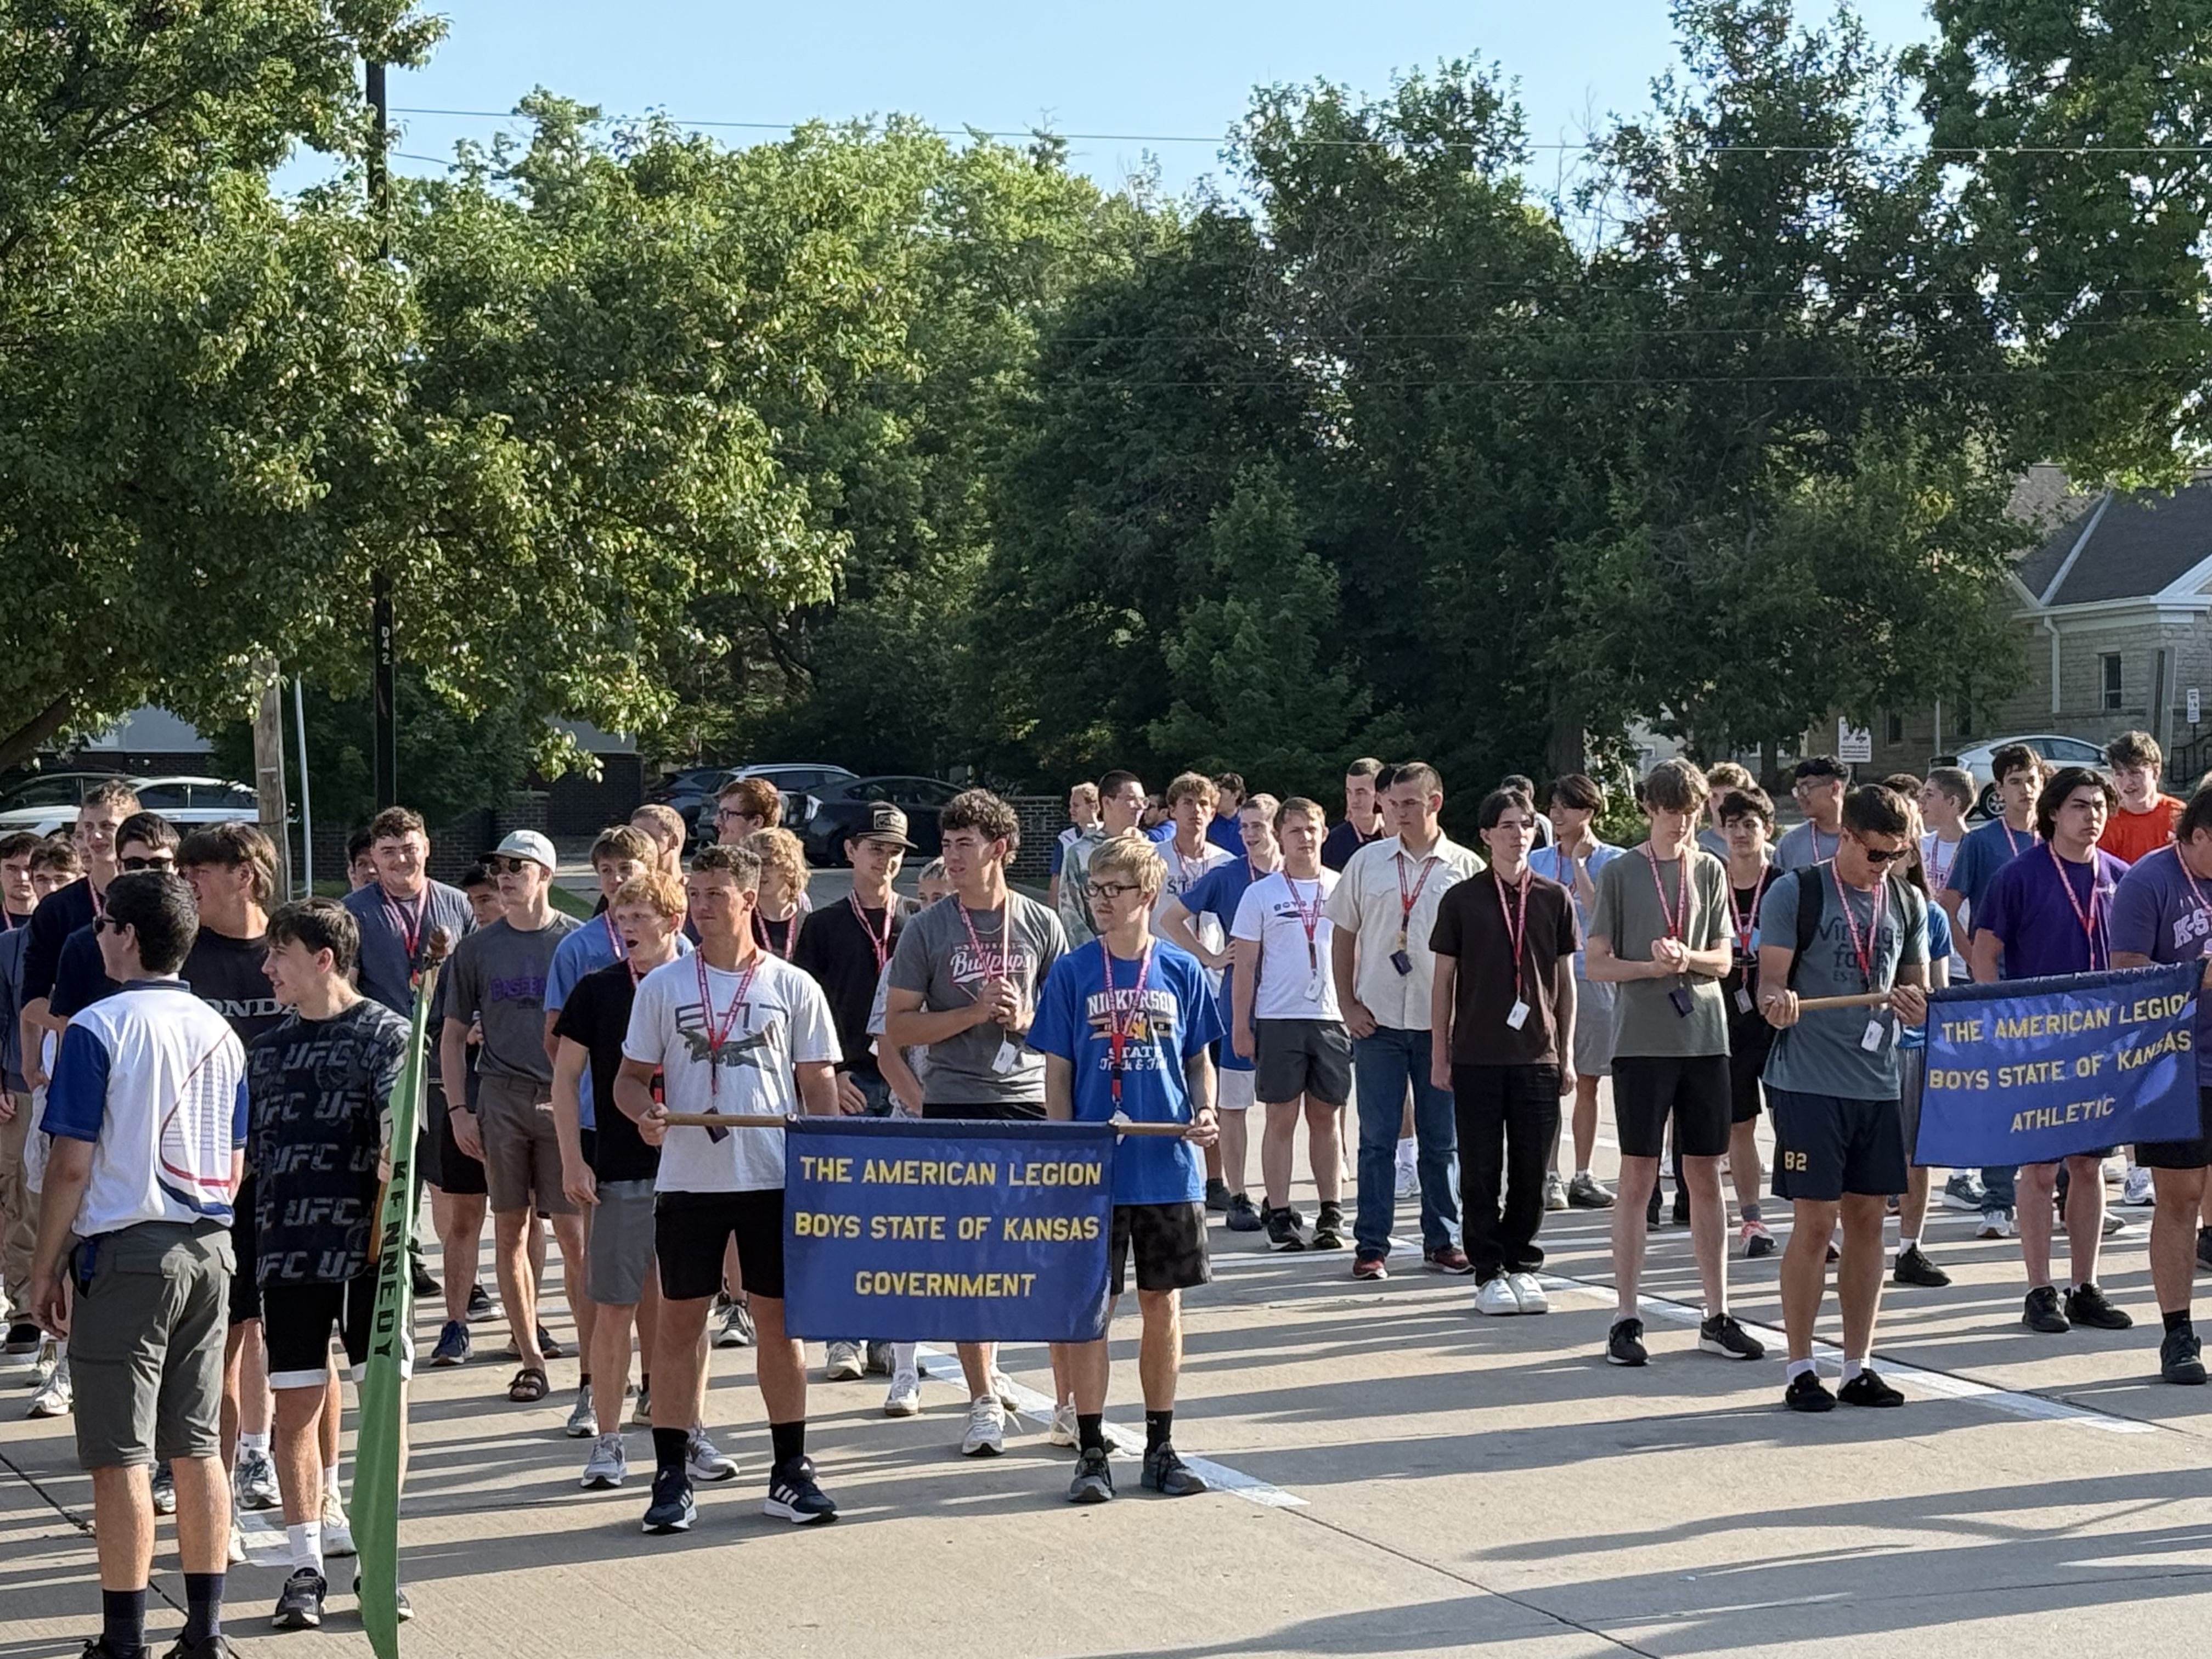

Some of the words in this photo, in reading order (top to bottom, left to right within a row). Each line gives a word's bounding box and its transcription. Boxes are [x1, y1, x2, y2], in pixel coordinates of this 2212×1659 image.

[204, 998, 300, 1017] ONDA
[1942, 1020, 1984, 1043] THE
[1994, 1007, 2111, 1039] AMERICAN
[1929, 1069, 1990, 1090] BOYS
[1997, 1060, 2066, 1088] STATE
[2075, 1053, 2104, 1078] OF
[2117, 1029, 2192, 1072] KANSAS
[313, 1091, 368, 1119] UF
[2010, 1097, 2116, 1134] ATHLETIC
[799, 1155, 854, 1183] THE
[861, 1158, 996, 1186] AMERICAN
[1008, 1161, 1102, 1186] LEGION
[282, 1198, 362, 1227] UFC
[794, 1211, 861, 1238] BOYS
[870, 1215, 946, 1240] STATE
[958, 1216, 992, 1240] OF
[1003, 1216, 1100, 1242] KANSAS
[317, 1251, 367, 1278] UF
[855, 1268, 1037, 1297] GOVERNMENT
